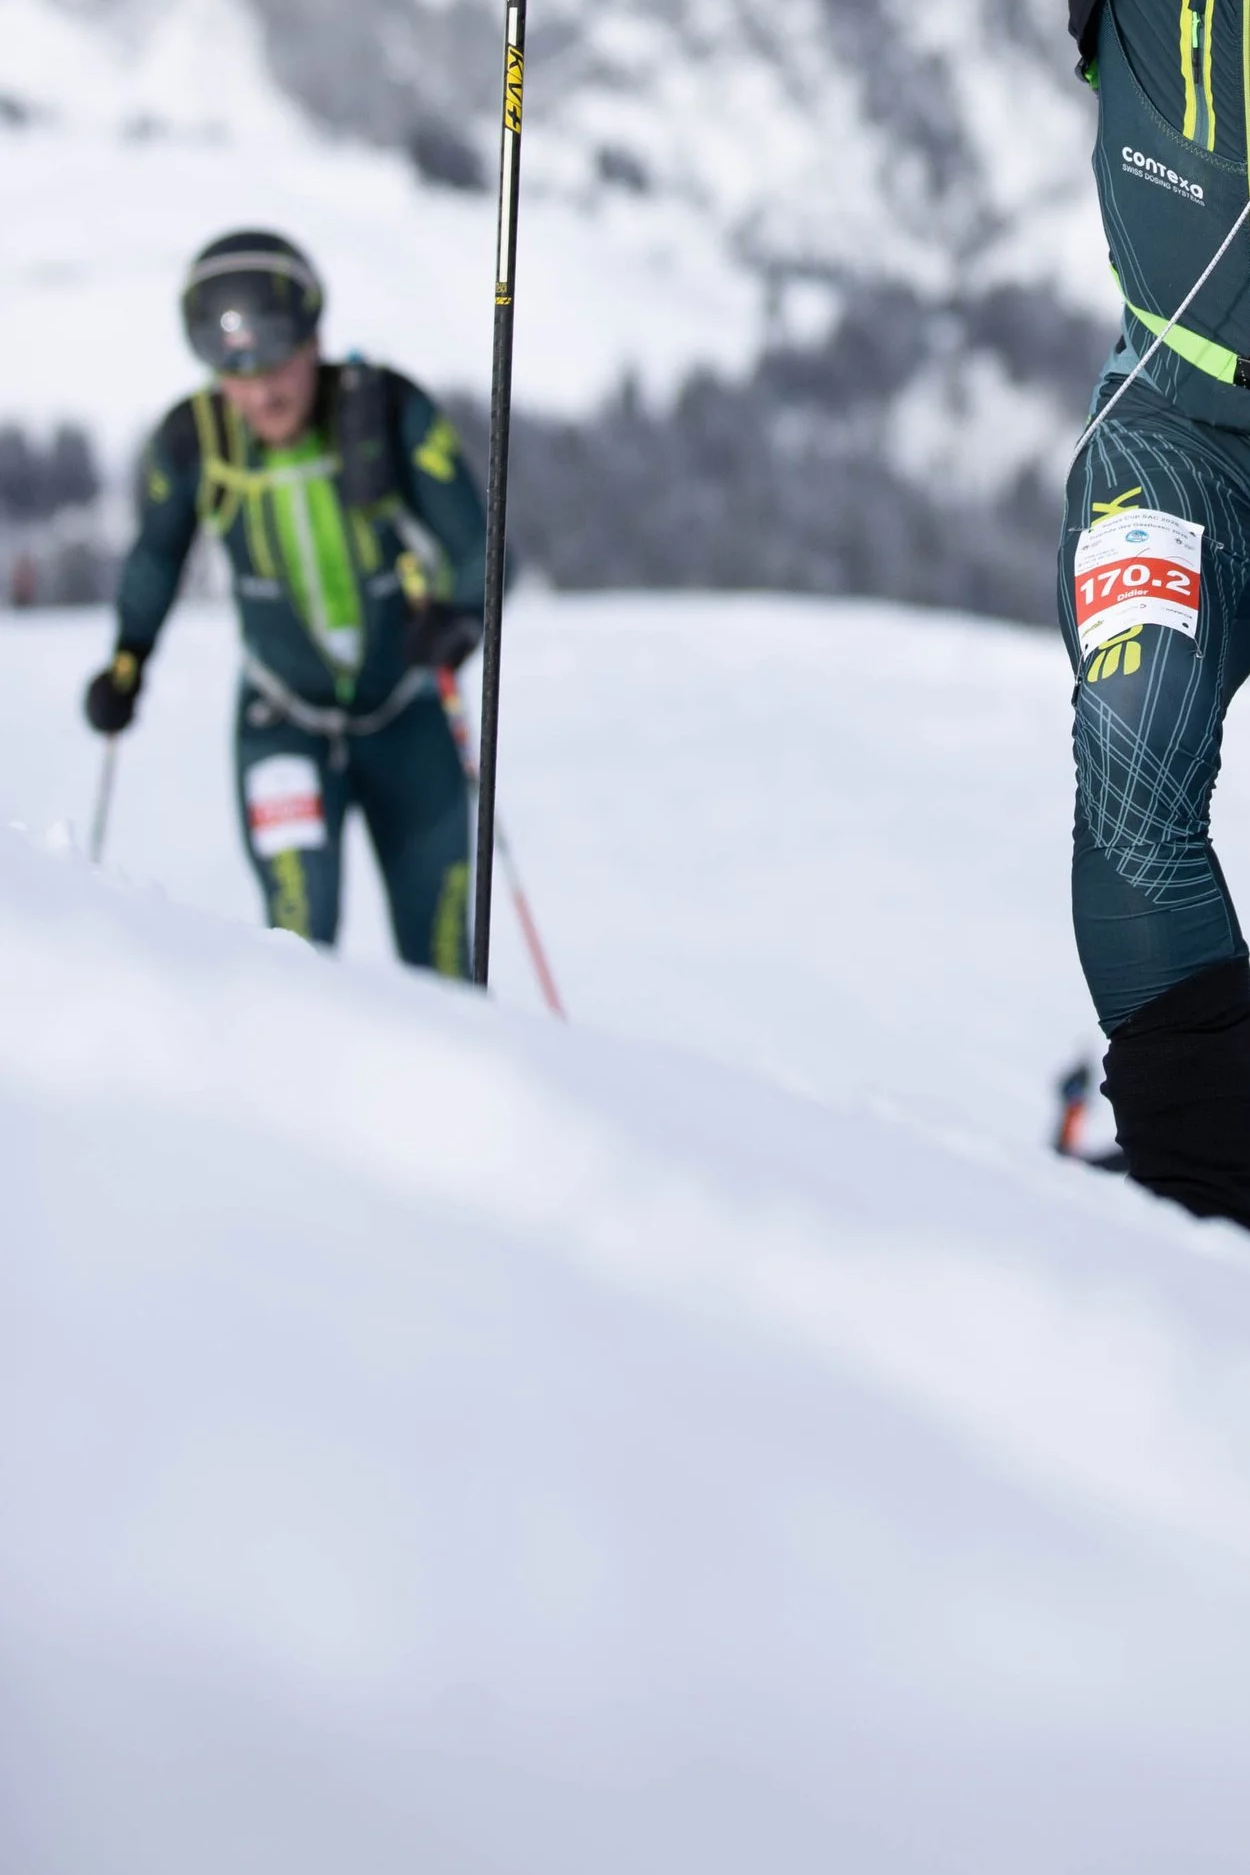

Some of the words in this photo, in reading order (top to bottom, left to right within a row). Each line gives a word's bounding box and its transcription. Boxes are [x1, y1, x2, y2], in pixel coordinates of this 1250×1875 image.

[1122, 163, 1144, 178] SWISS
[1144, 172, 1171, 190] DOSING
[1172, 185, 1206, 207] SYSTEMS
[1080, 564, 1191, 605] 170.2
[1116, 588, 1150, 602] Didier
